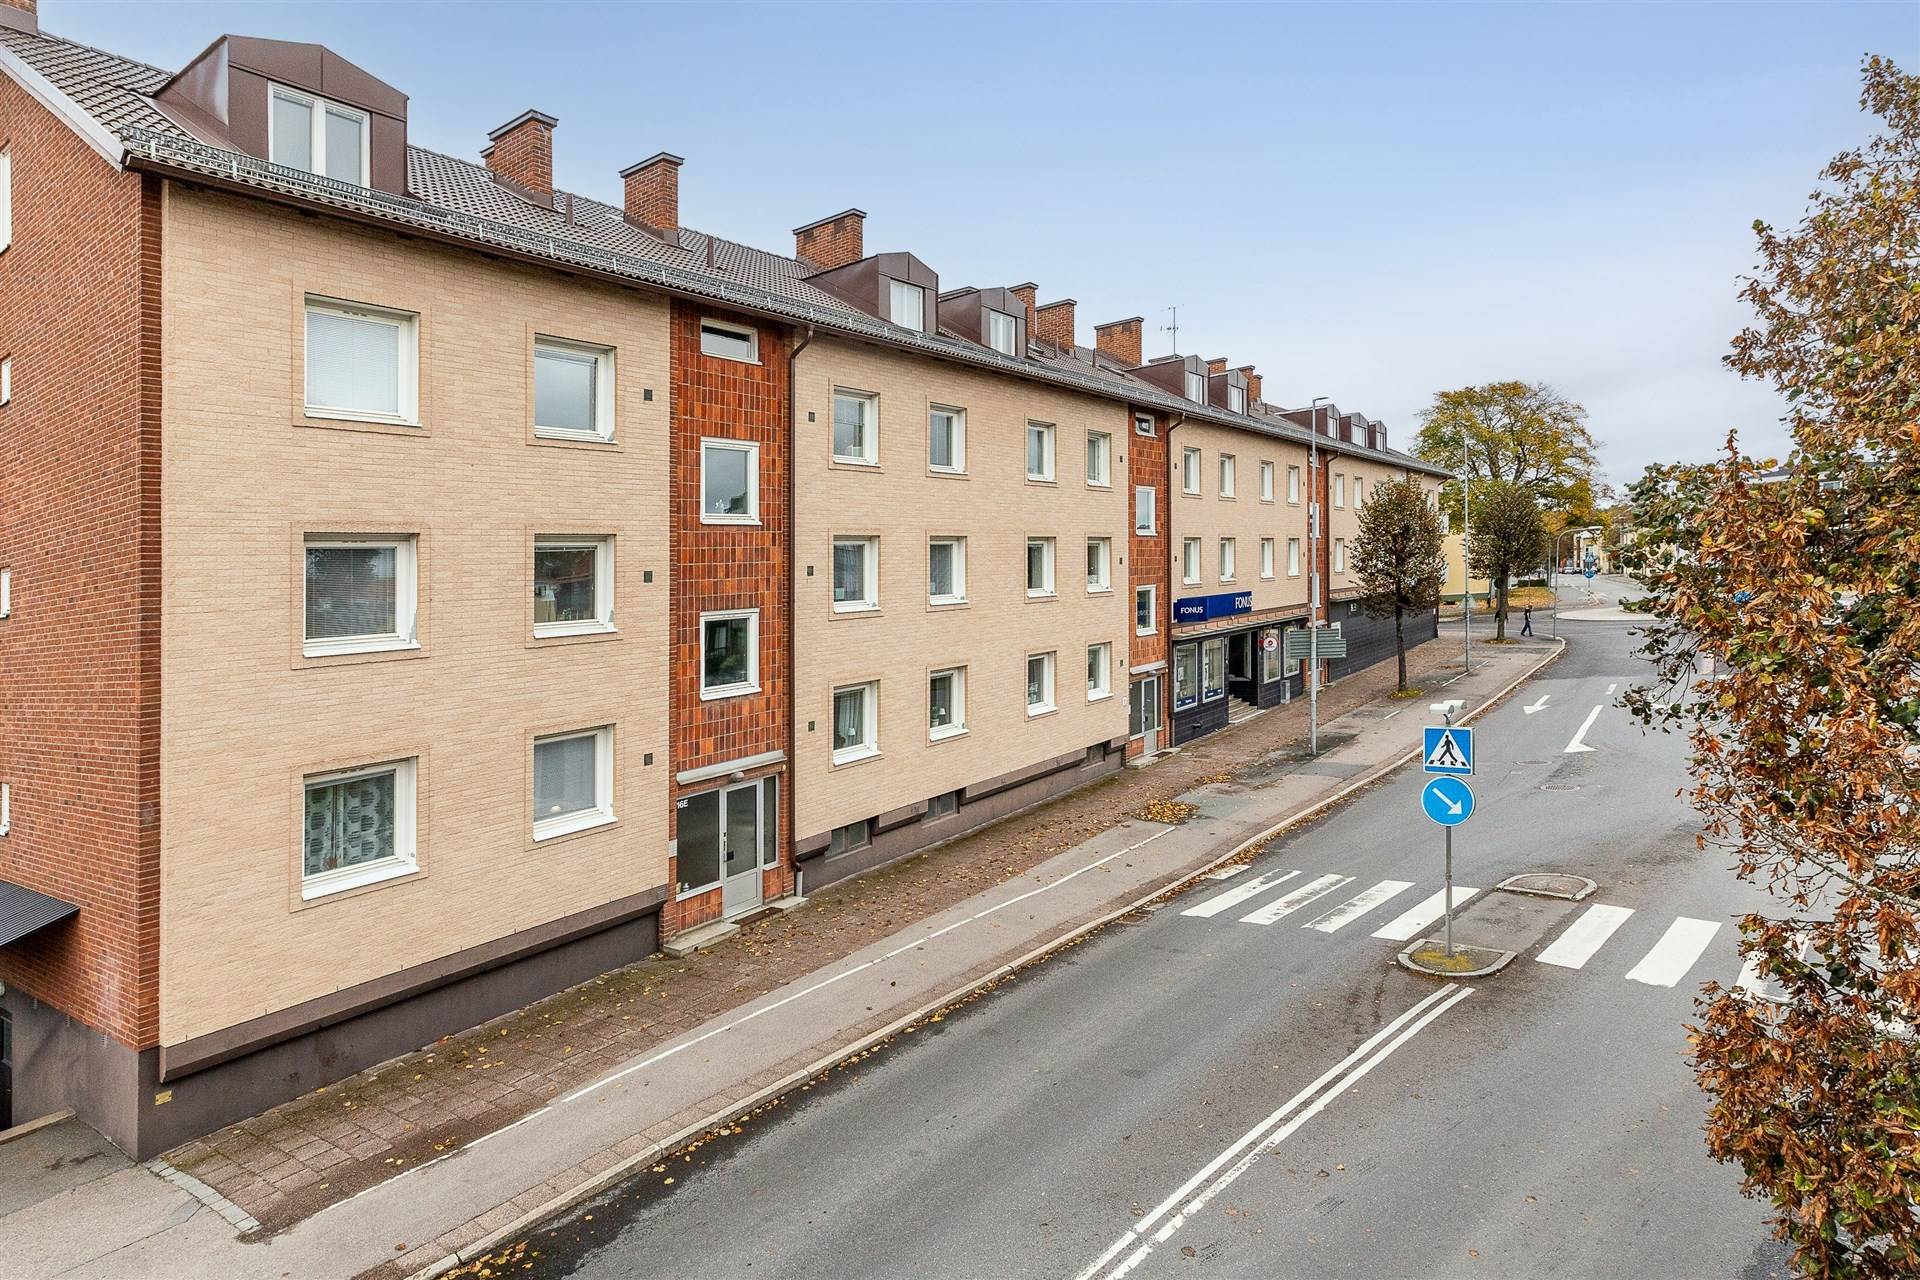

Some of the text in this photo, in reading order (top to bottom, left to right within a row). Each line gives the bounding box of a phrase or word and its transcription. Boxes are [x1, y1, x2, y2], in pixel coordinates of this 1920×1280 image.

[1235, 596, 1253, 609] FONUS
[1180, 606, 1204, 615] FONUS
[677, 799, 689, 809] 16E
